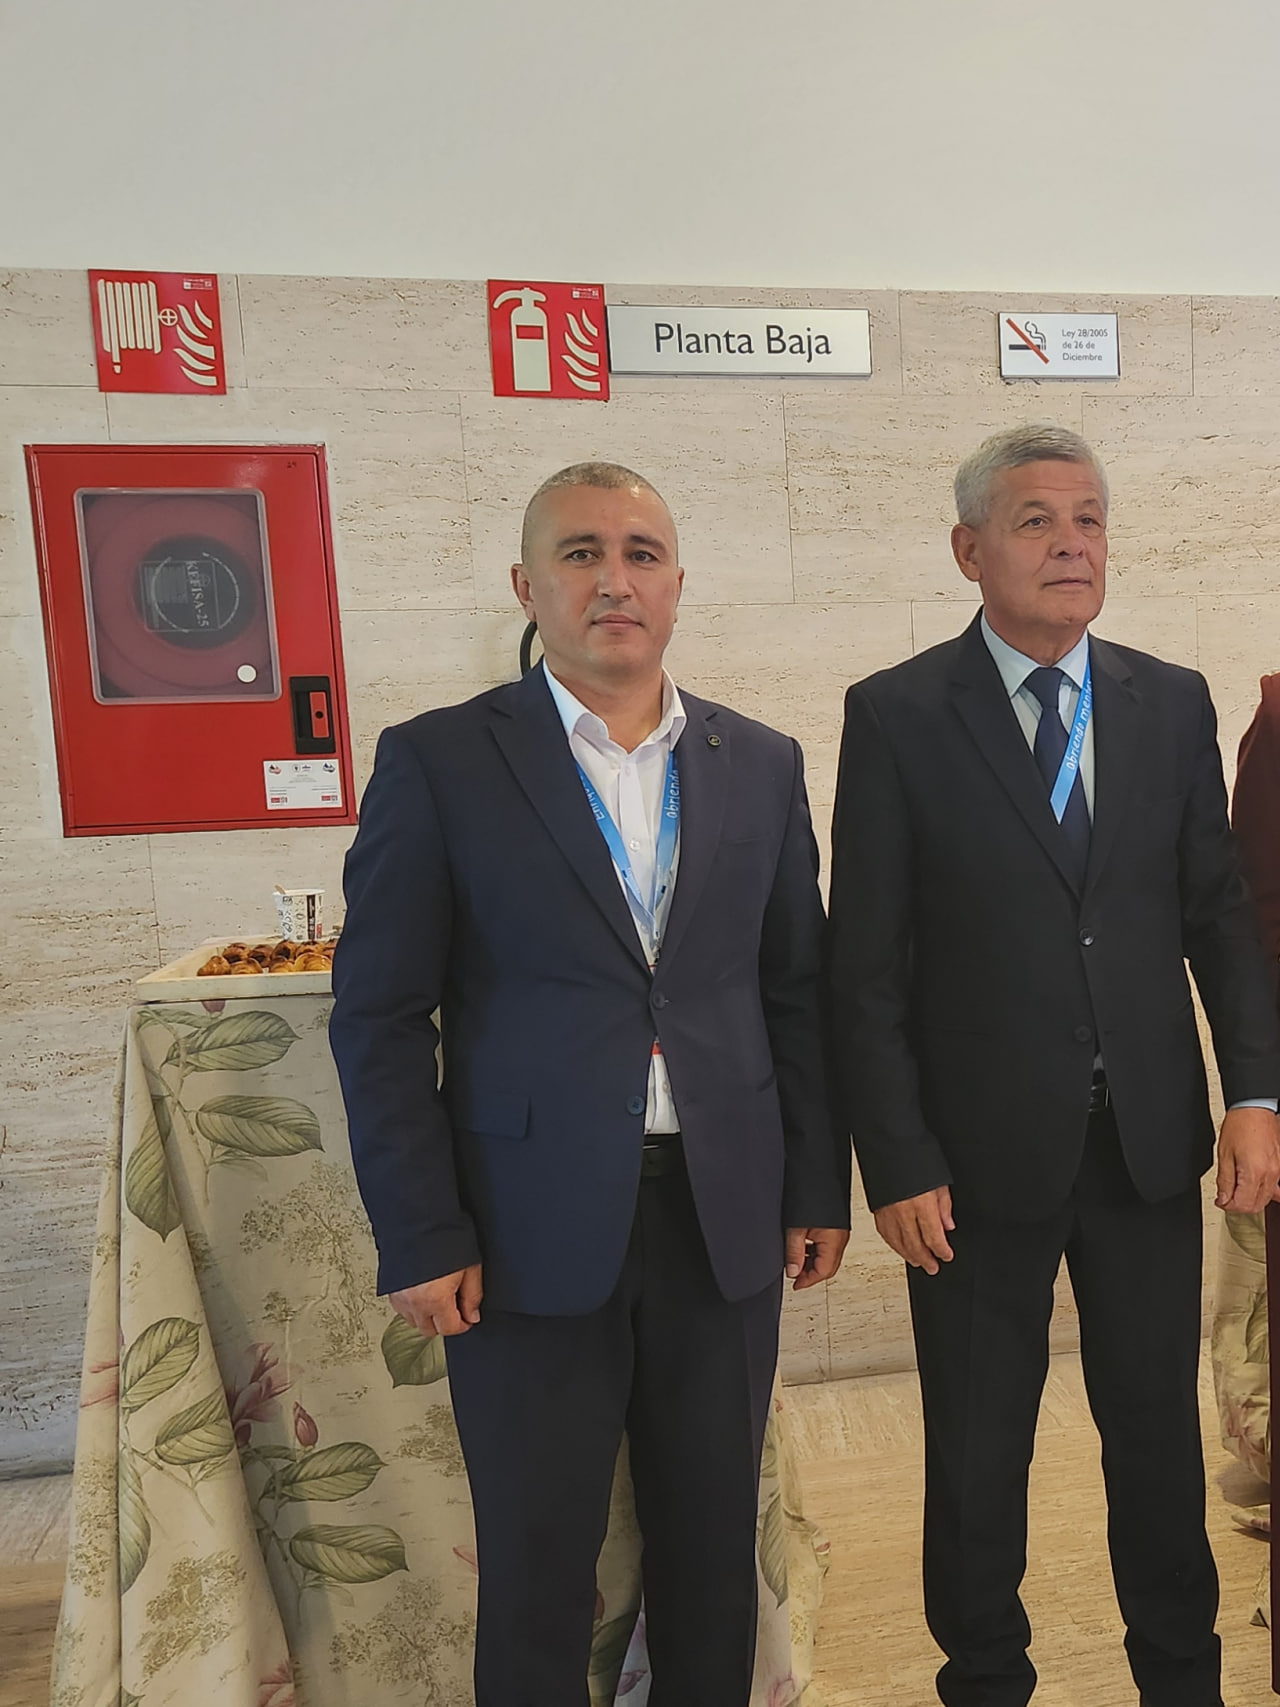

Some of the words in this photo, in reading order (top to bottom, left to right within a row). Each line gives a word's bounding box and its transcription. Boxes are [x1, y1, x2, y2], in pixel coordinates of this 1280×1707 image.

[1061, 329, 1076, 339] Ley
[1077, 328, 1109, 338] 28/2005
[654, 322, 755, 354] Planta
[765, 324, 832, 364] Baja
[1062, 341, 1072, 350] de
[1074, 341, 1085, 350] 26
[1085, 341, 1096, 350] de
[1062, 352, 1103, 362] Diciembre
